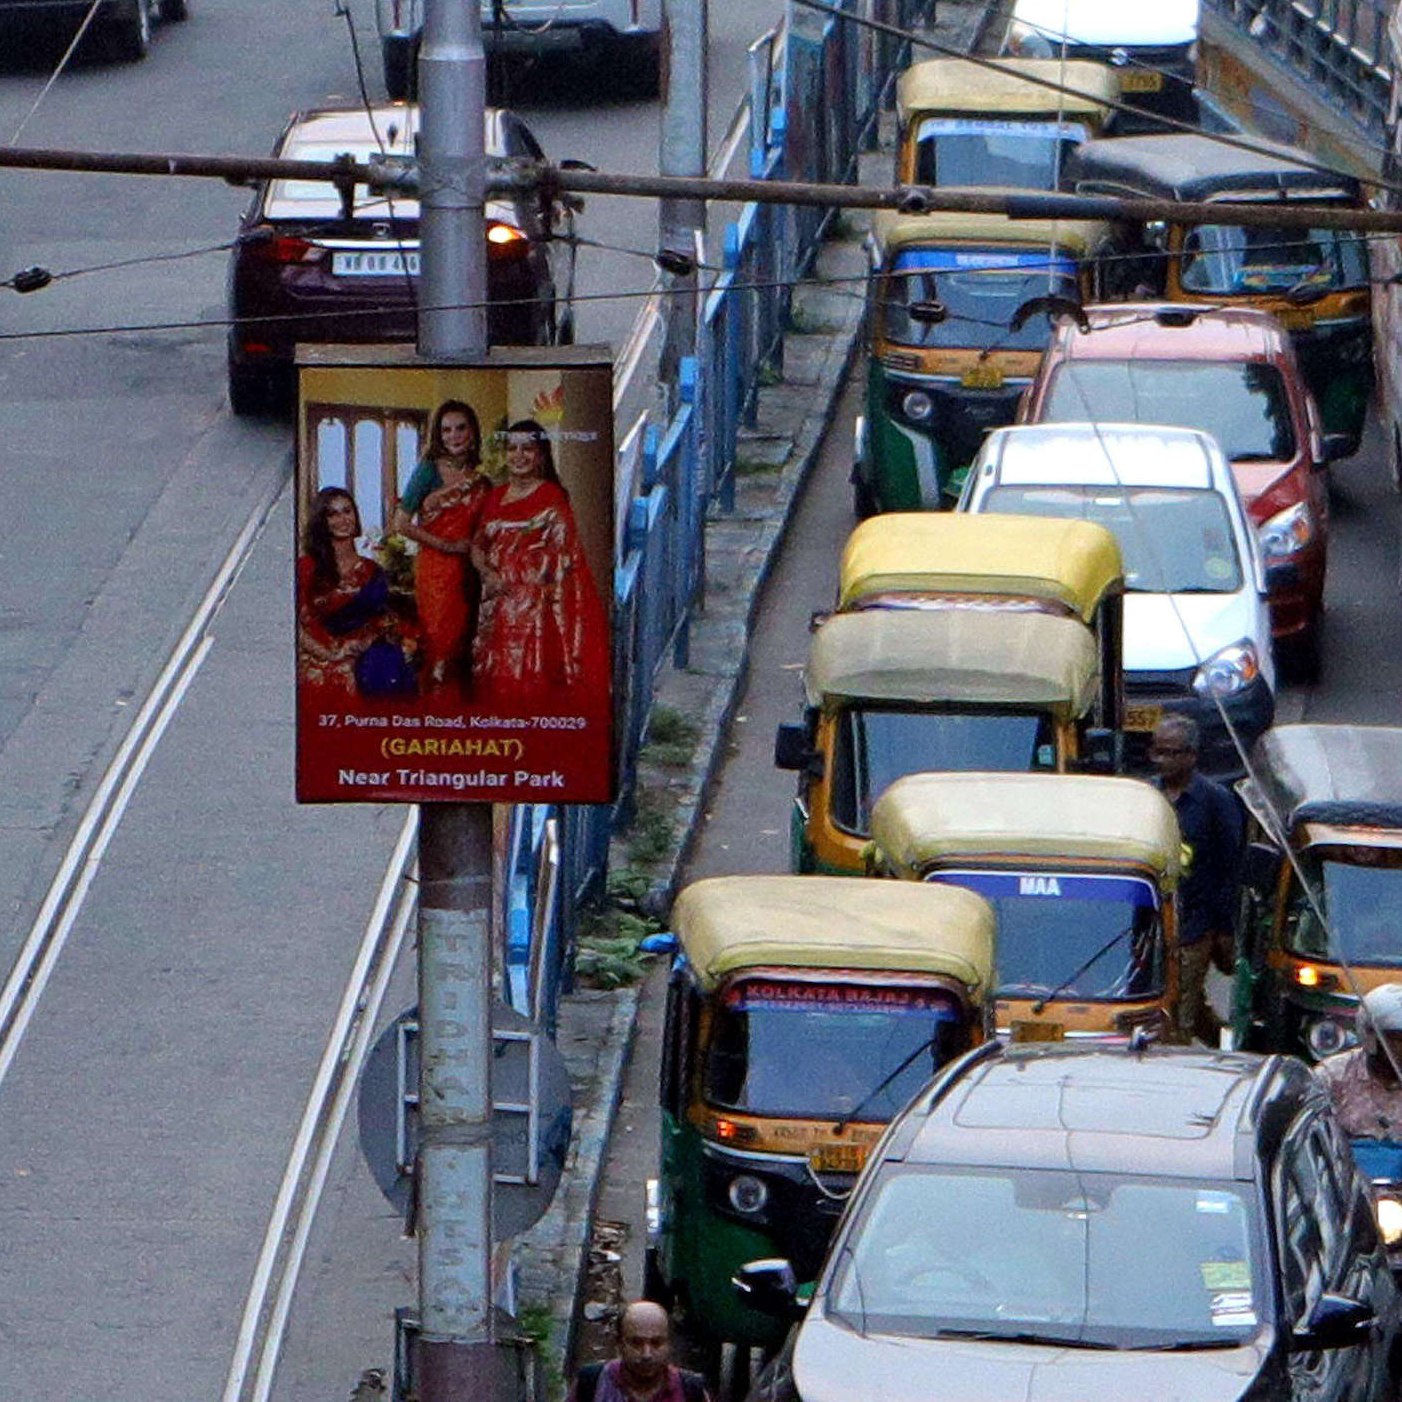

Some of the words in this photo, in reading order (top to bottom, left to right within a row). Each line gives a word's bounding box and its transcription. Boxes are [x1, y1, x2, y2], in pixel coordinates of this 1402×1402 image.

[318, 714, 341, 729] 37,
[344, 714, 387, 728] Purna
[392, 714, 421, 728] Das
[424, 715, 467, 730] Road,
[381, 737, 525, 761] (GARIAHAT)
[339, 769, 388, 786] Near
[396, 769, 508, 789] Triangular
[514, 770, 565, 788] Park
[1019, 876, 1062, 897] MAA
[747, 984, 840, 1001] KOLKATA
